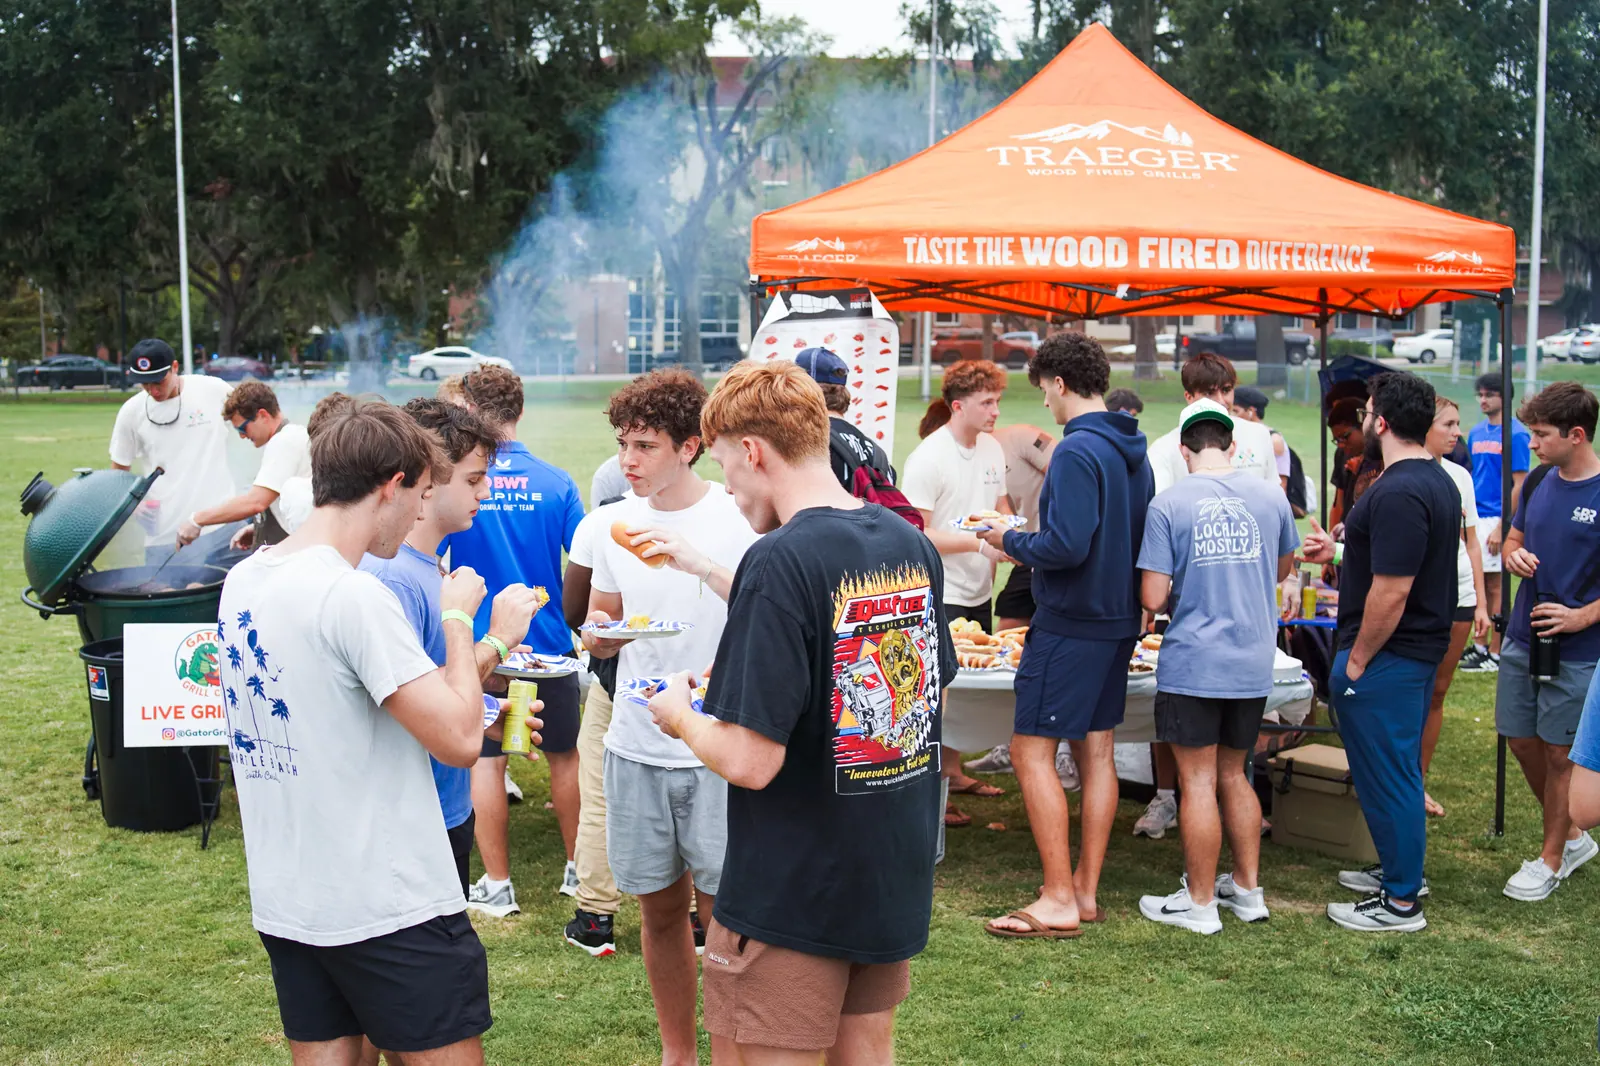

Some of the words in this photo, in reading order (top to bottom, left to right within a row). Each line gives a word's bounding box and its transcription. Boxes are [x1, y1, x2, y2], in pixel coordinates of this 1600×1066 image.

[1027, 168, 1077, 176] WOOD
[1086, 168, 1135, 177] FIRED
[1143, 170, 1202, 180] GRILLS
[903, 236, 968, 265] TASTE
[973, 236, 1015, 265] THE
[1020, 235, 1129, 269] WOOD
[1138, 236, 1240, 270] FIRED
[1245, 239, 1375, 273] DIFFERENCE
[493, 475, 529, 490] BWT
[484, 492, 543, 501] PINE
[479, 503, 502, 511] ORMULA
[518, 503, 534, 511] TEAM
[1194, 521, 1249, 541] LOCALS
[1194, 538, 1249, 556] MOSTLY
[185, 632, 219, 649] GATO
[182, 680, 210, 698] GRILL
[141, 705, 185, 720] LIVE
[191, 704, 225, 719] GRI
[176, 728, 227, 738] @GatorGri
